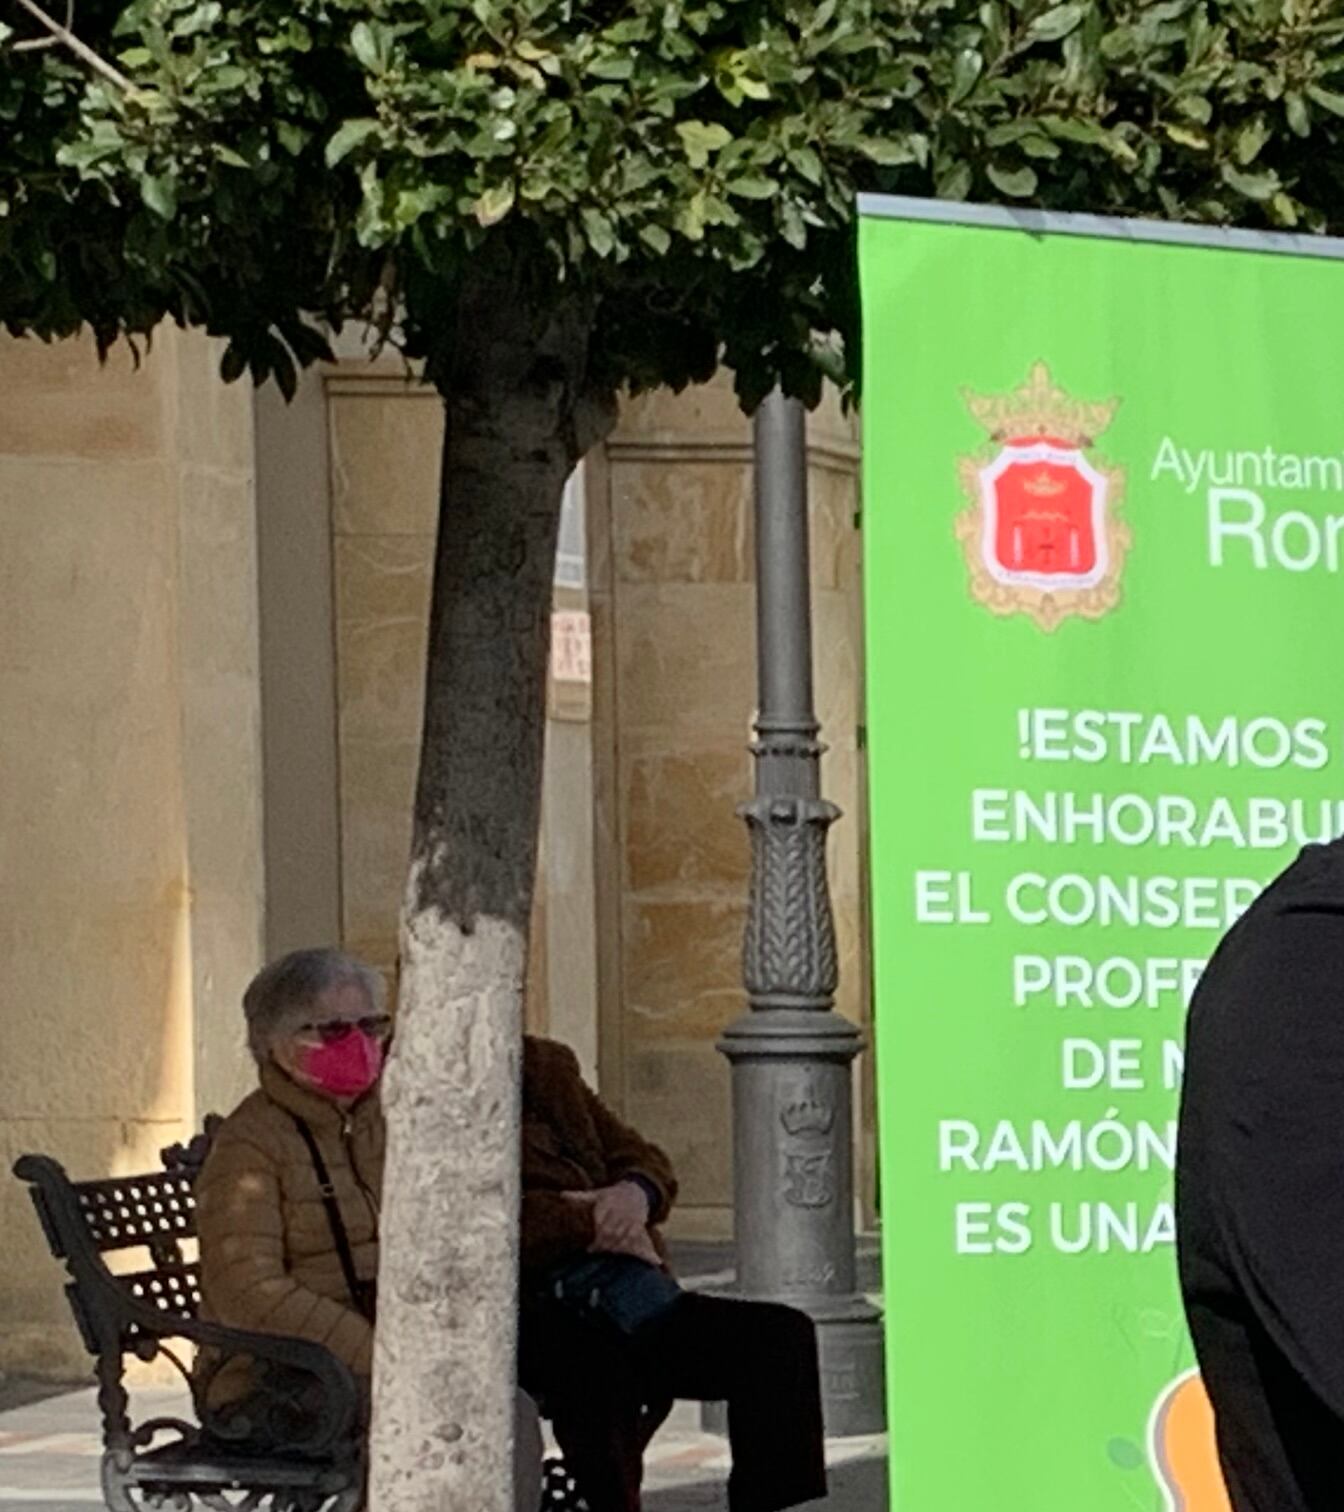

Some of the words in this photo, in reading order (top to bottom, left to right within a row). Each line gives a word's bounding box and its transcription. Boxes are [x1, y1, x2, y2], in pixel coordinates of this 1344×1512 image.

[913, 869, 991, 924] EL
[1061, 1036, 1145, 1090] DE
[937, 1106, 1179, 1173] RAMÓN
[953, 1201, 1033, 1255] ES
[1049, 1201, 1177, 1254] UNA
